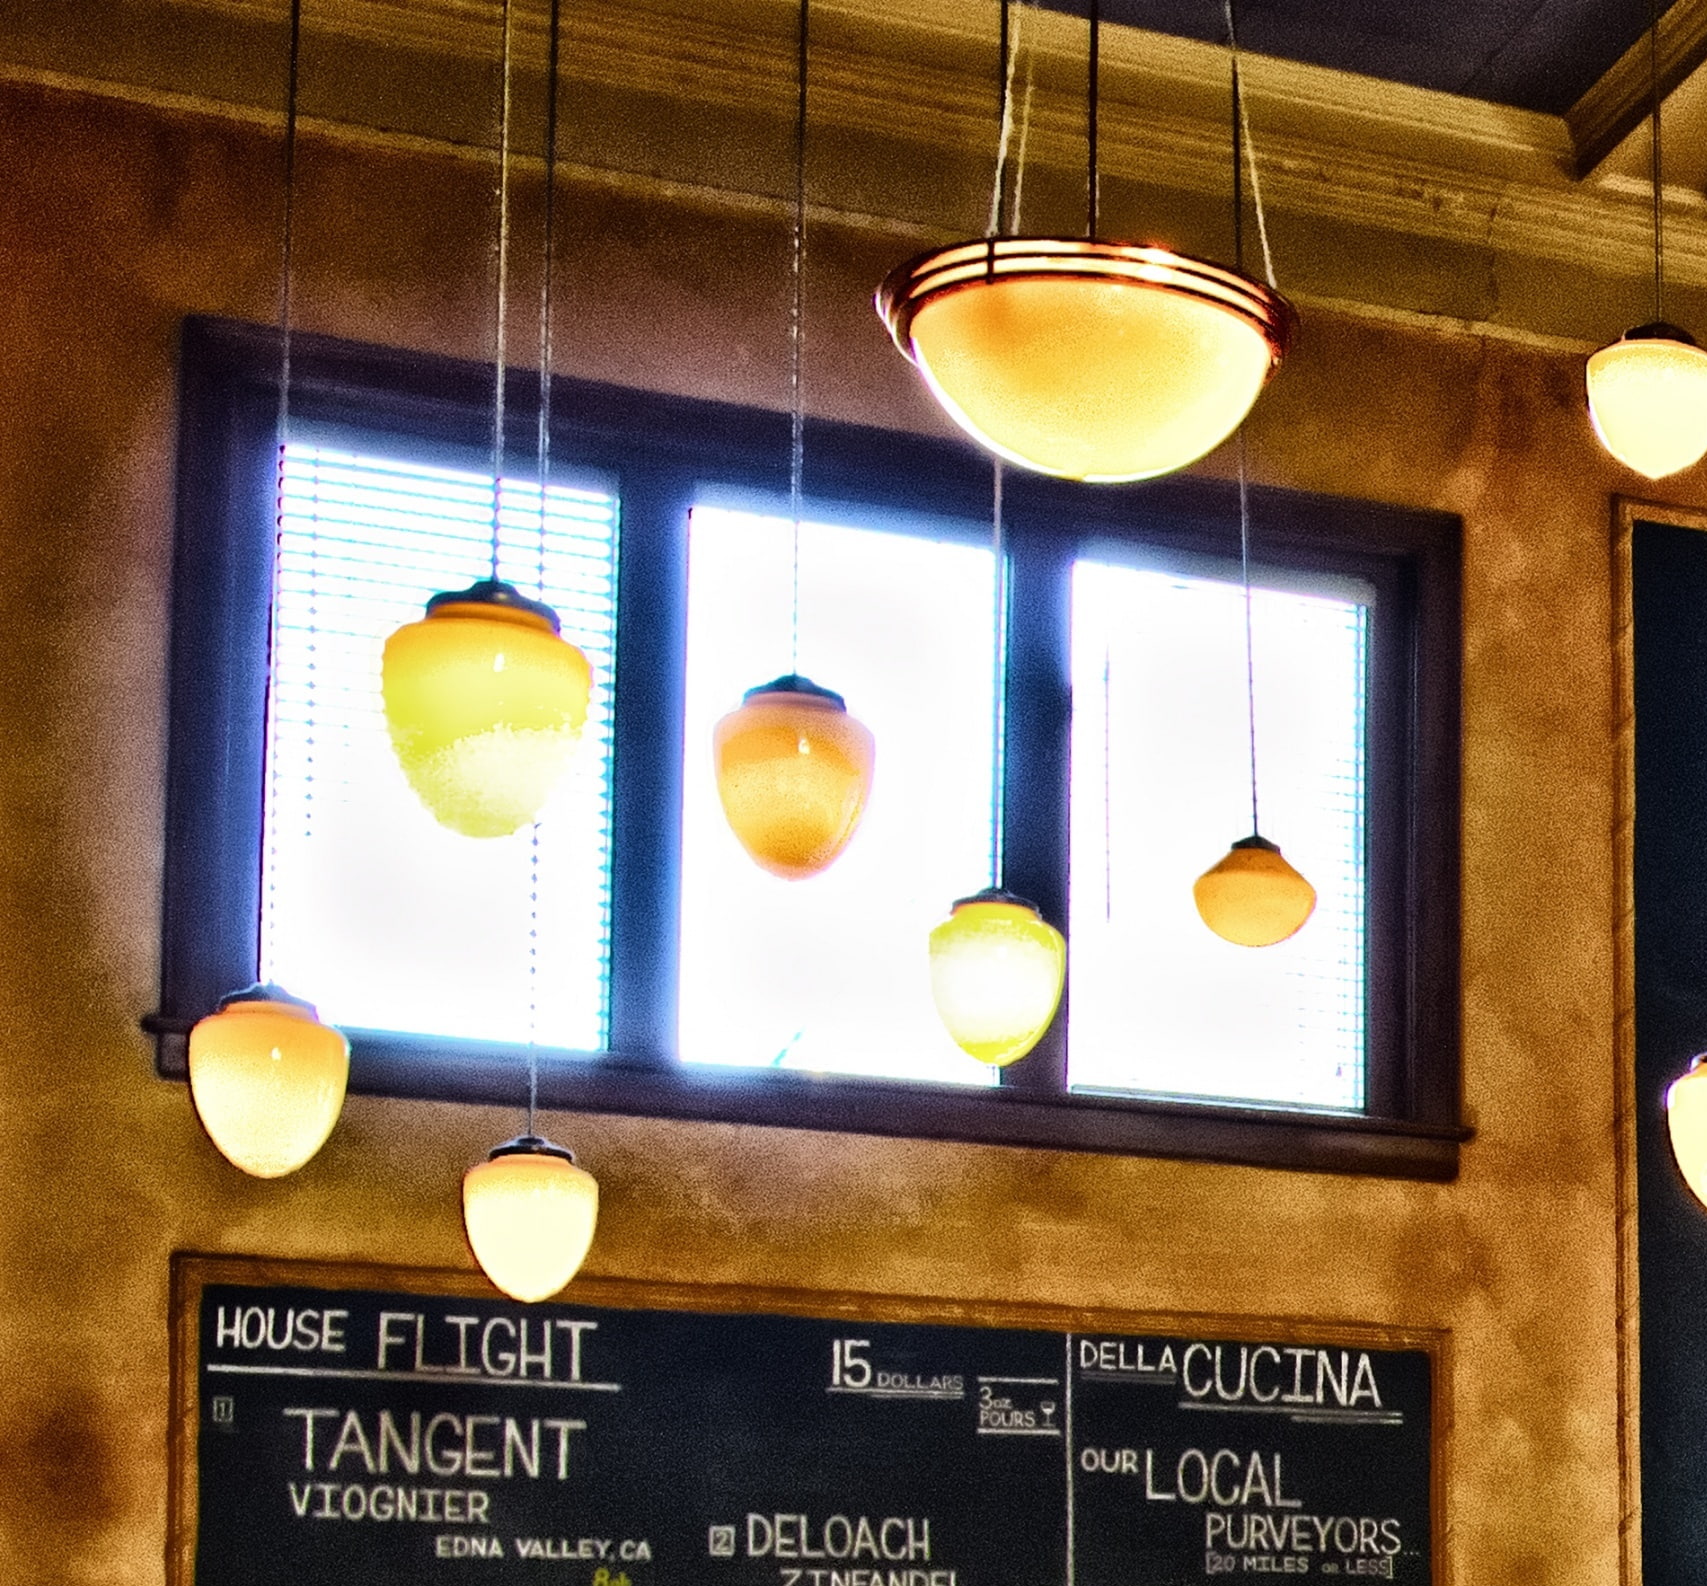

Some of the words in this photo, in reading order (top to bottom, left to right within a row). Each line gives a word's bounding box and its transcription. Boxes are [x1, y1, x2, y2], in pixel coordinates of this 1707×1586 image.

[214, 1305, 350, 1353] HOUSE
[376, 1311, 600, 1382] FLIGHT
[832, 1338, 872, 1388] 15
[875, 1370, 964, 1391] DOLLARS
[1080, 1340, 1177, 1374] DELLA
[1182, 1343, 1383, 1408] CUCINA
[282, 1405, 588, 1480] TANGENT
[979, 1410, 1036, 1428] POURS
[287, 1482, 492, 1524] VIOGNIER
[1081, 1448, 1139, 1474] OUR
[1145, 1448, 1303, 1508] LOCAL
[435, 1535, 504, 1559] EDNA
[746, 1513, 933, 1561] DELOACH
[1243, 1554, 1310, 1574] MILES
